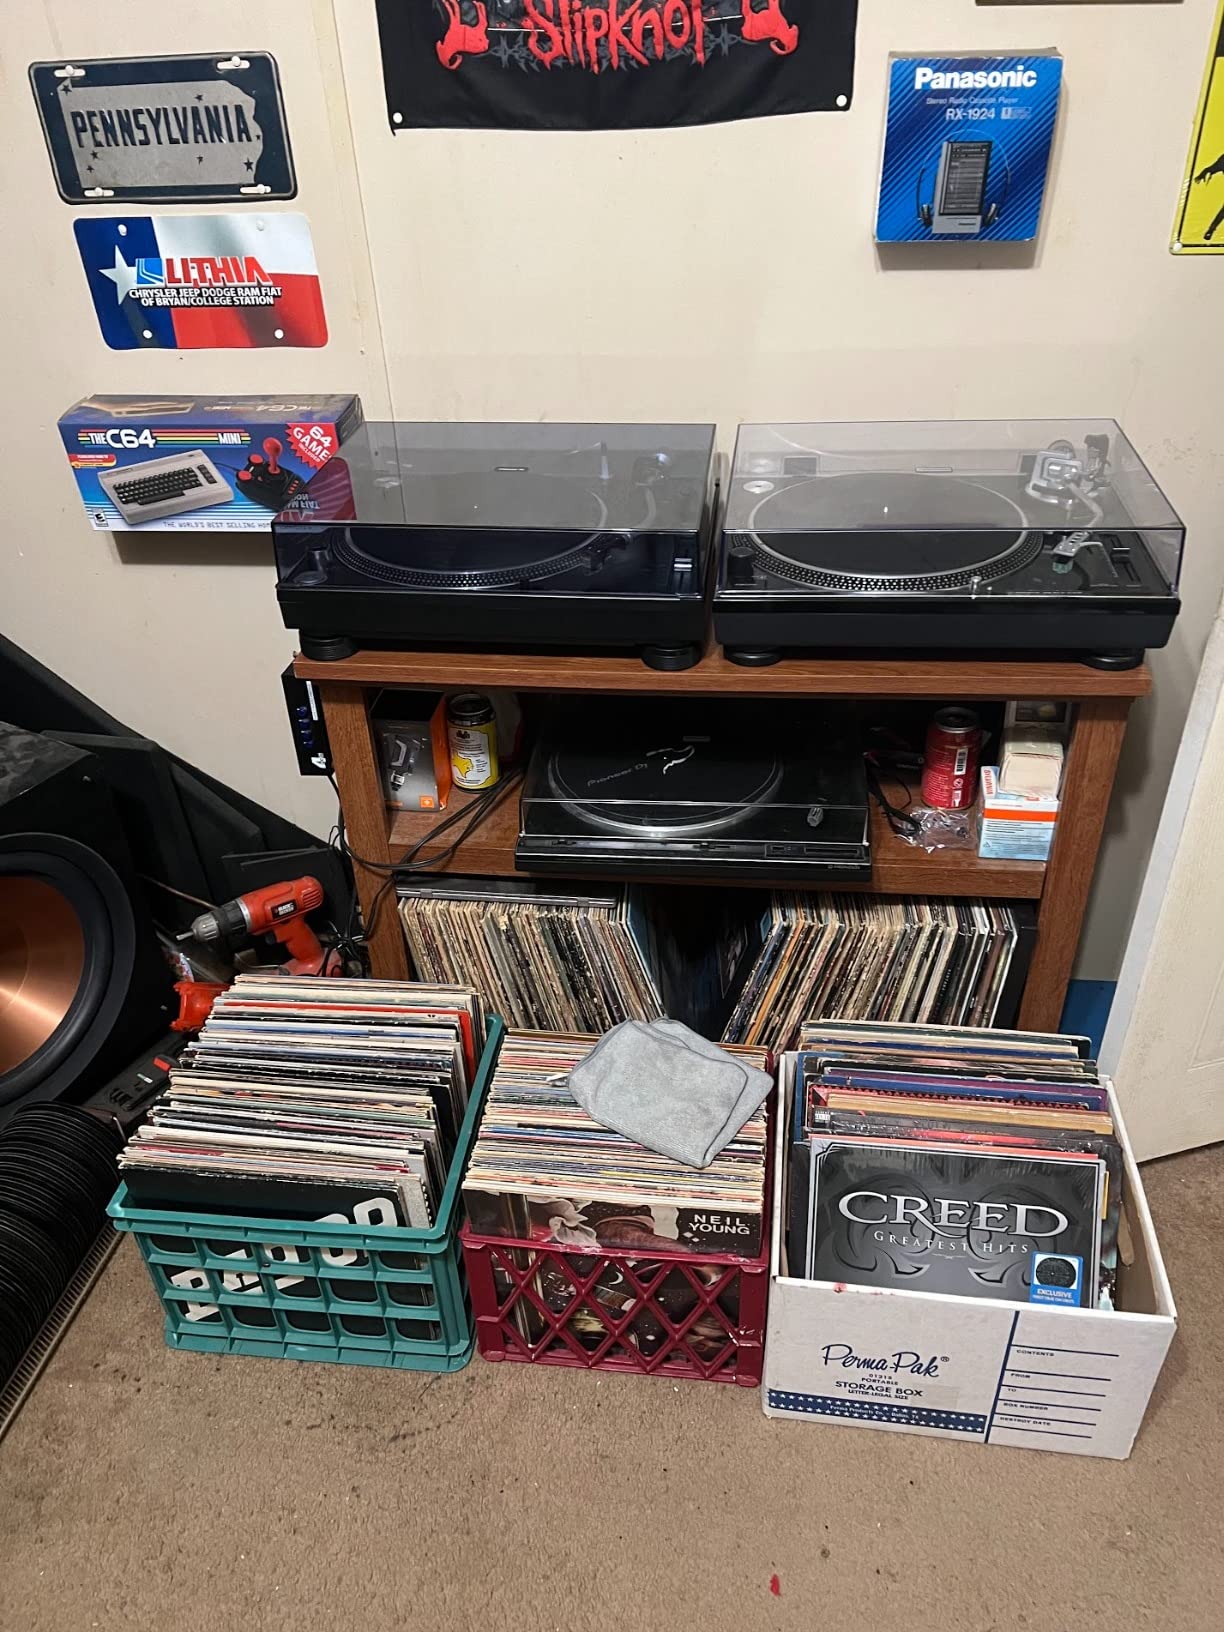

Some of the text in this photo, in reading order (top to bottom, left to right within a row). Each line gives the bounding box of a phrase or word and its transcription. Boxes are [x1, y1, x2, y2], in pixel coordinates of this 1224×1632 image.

[914, 65, 1037, 90] Panasonic
[945, 107, 996, 120] RX-1924
[70, 104, 252, 149] PENNSYLVANIA
[165, 256, 273, 286] LITHIA
[129, 287, 282, 299] CHRYSLER JEEP DODGE RAM FIAT
[141, 296, 274, 307] OF BRYAN/COLLEGE STATION
[218, 433, 242, 444] MINI
[310, 426, 332, 447] 64
[587, 768, 631, 787] Pioneer
[694, 1214, 746, 1227] NEIL
[838, 1191, 1069, 1238] CREED
[689, 1222, 750, 1235] YOUNG
[874, 1230, 1029, 1253] GREATEST HITS
[1036, 1288, 1073, 1299] EXCLUSIVE
[1016, 1349, 1055, 1357] CONTENTS
[861, 1377, 899, 1386] PORTABLE
[835, 1381, 924, 1397] STORAGE BOX
[1020, 1403, 1049, 1411] NUMBER
